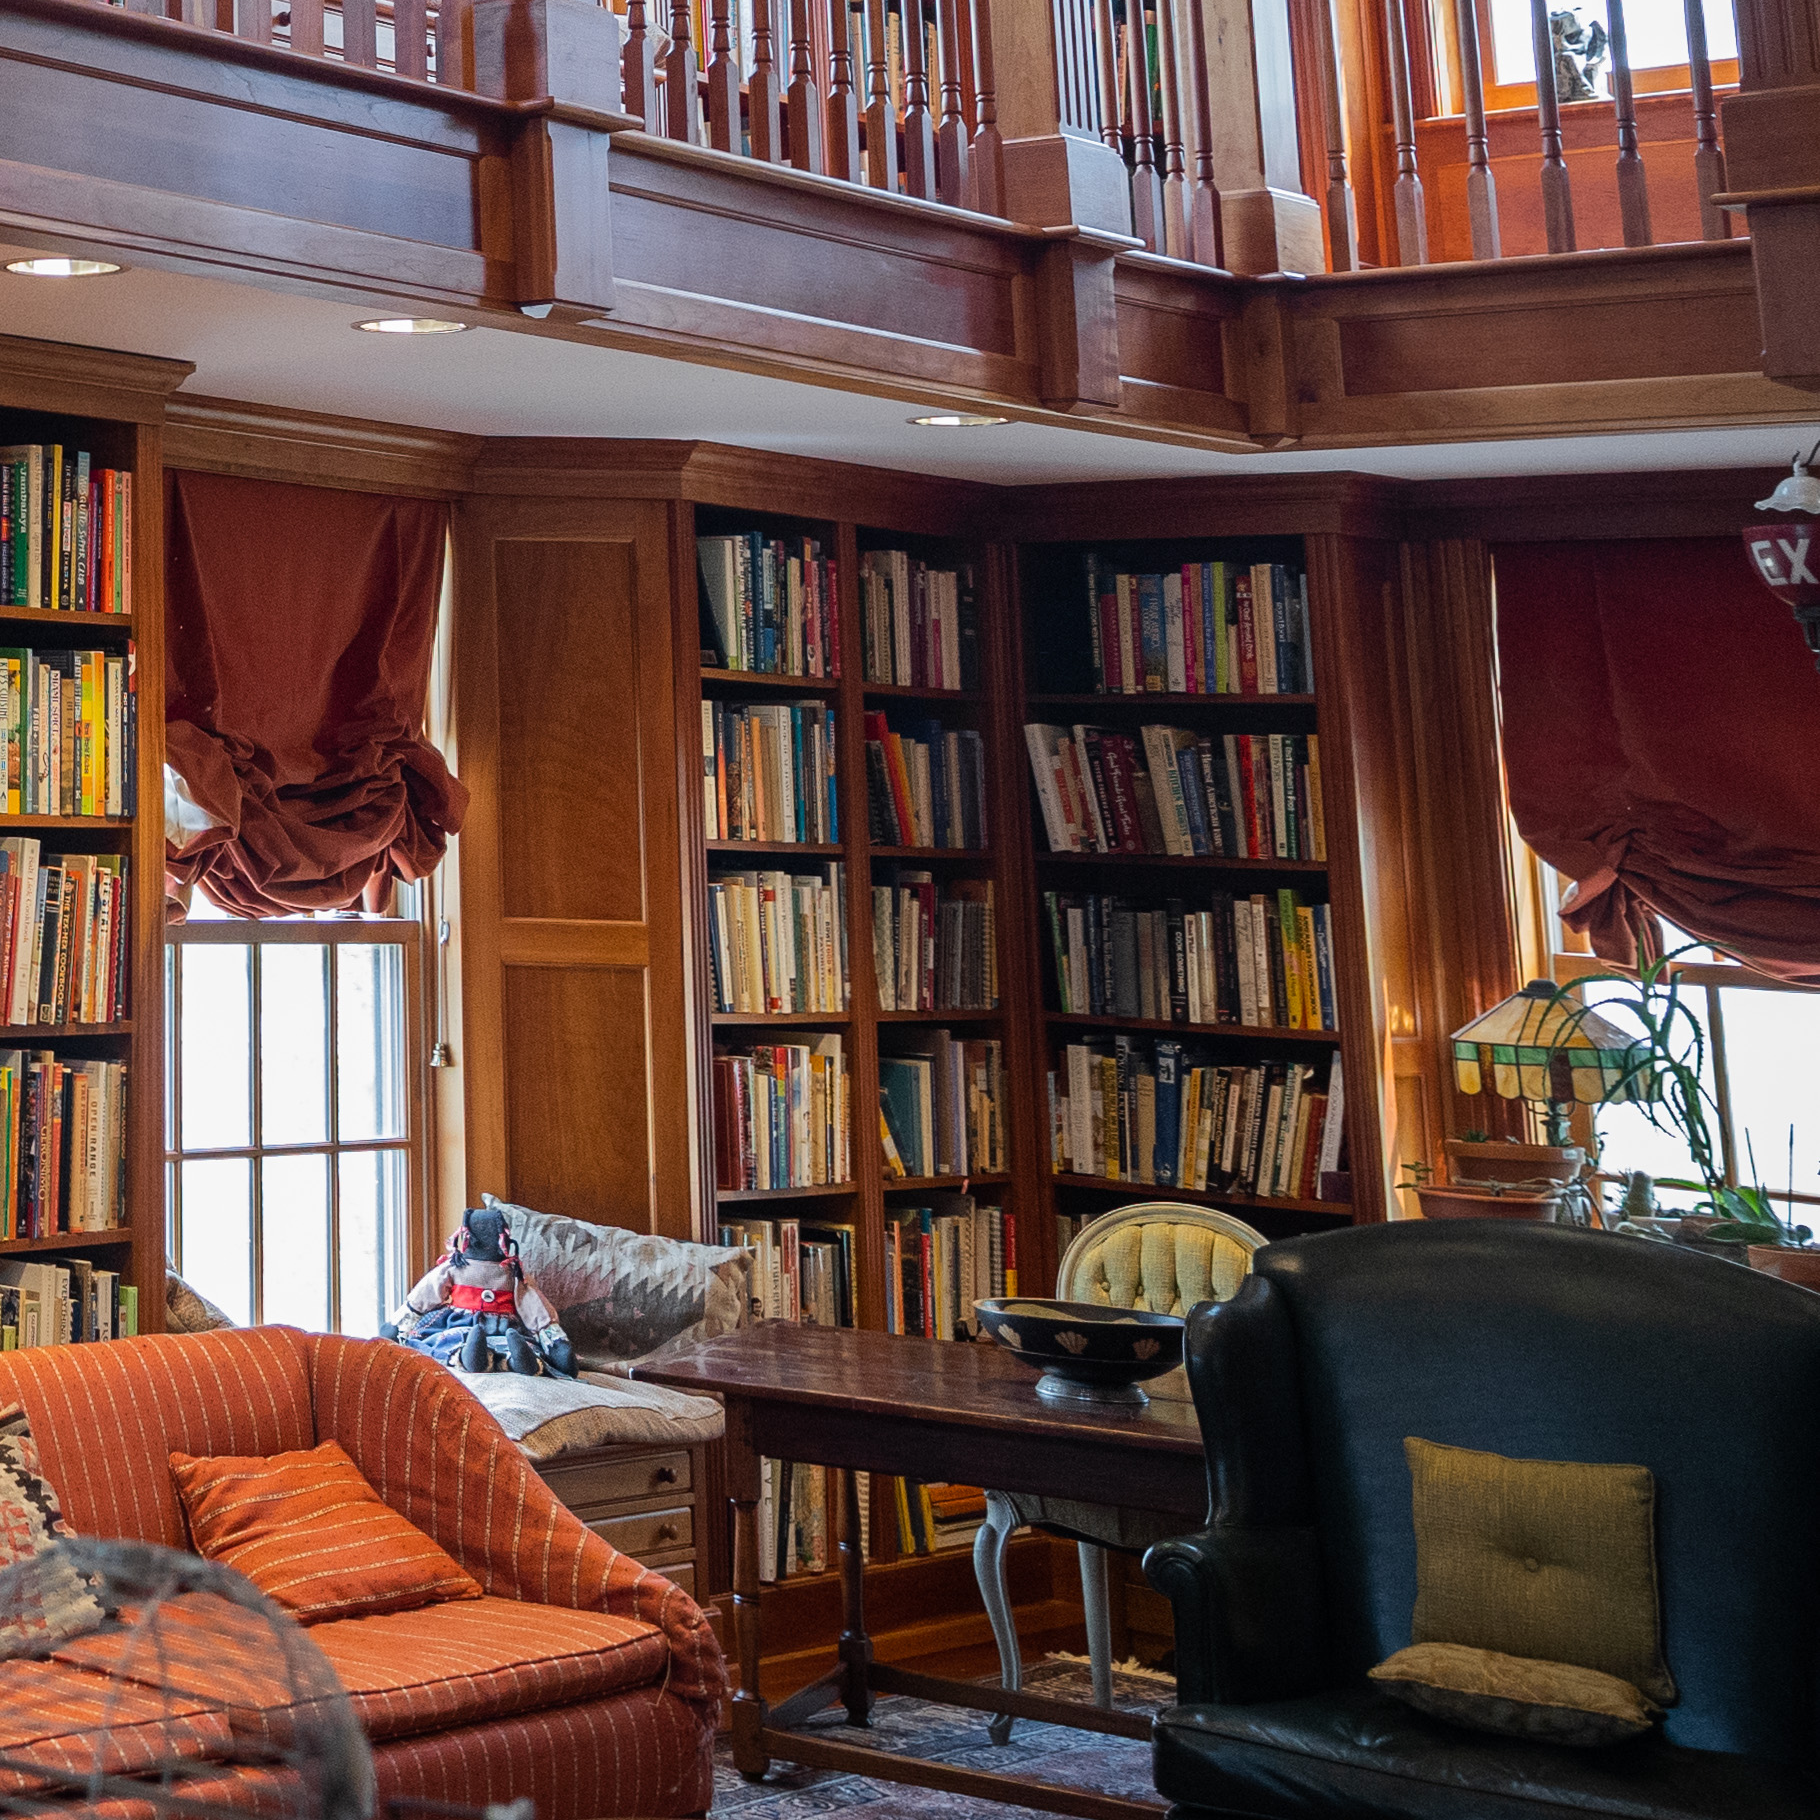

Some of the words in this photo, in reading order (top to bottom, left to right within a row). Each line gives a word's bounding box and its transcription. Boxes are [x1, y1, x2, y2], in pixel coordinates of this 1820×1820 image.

[19, 468, 28, 533] Jambalaya
[1201, 753, 1213, 784] Honest
[1205, 786, 1220, 826] American
[1212, 828, 1223, 847] Fare
[62, 895, 71, 911] THE
[59, 913, 70, 950] TEX-MEX
[57, 952, 67, 1007] COOKBOOK
[1175, 954, 1185, 993] SOMETHING
